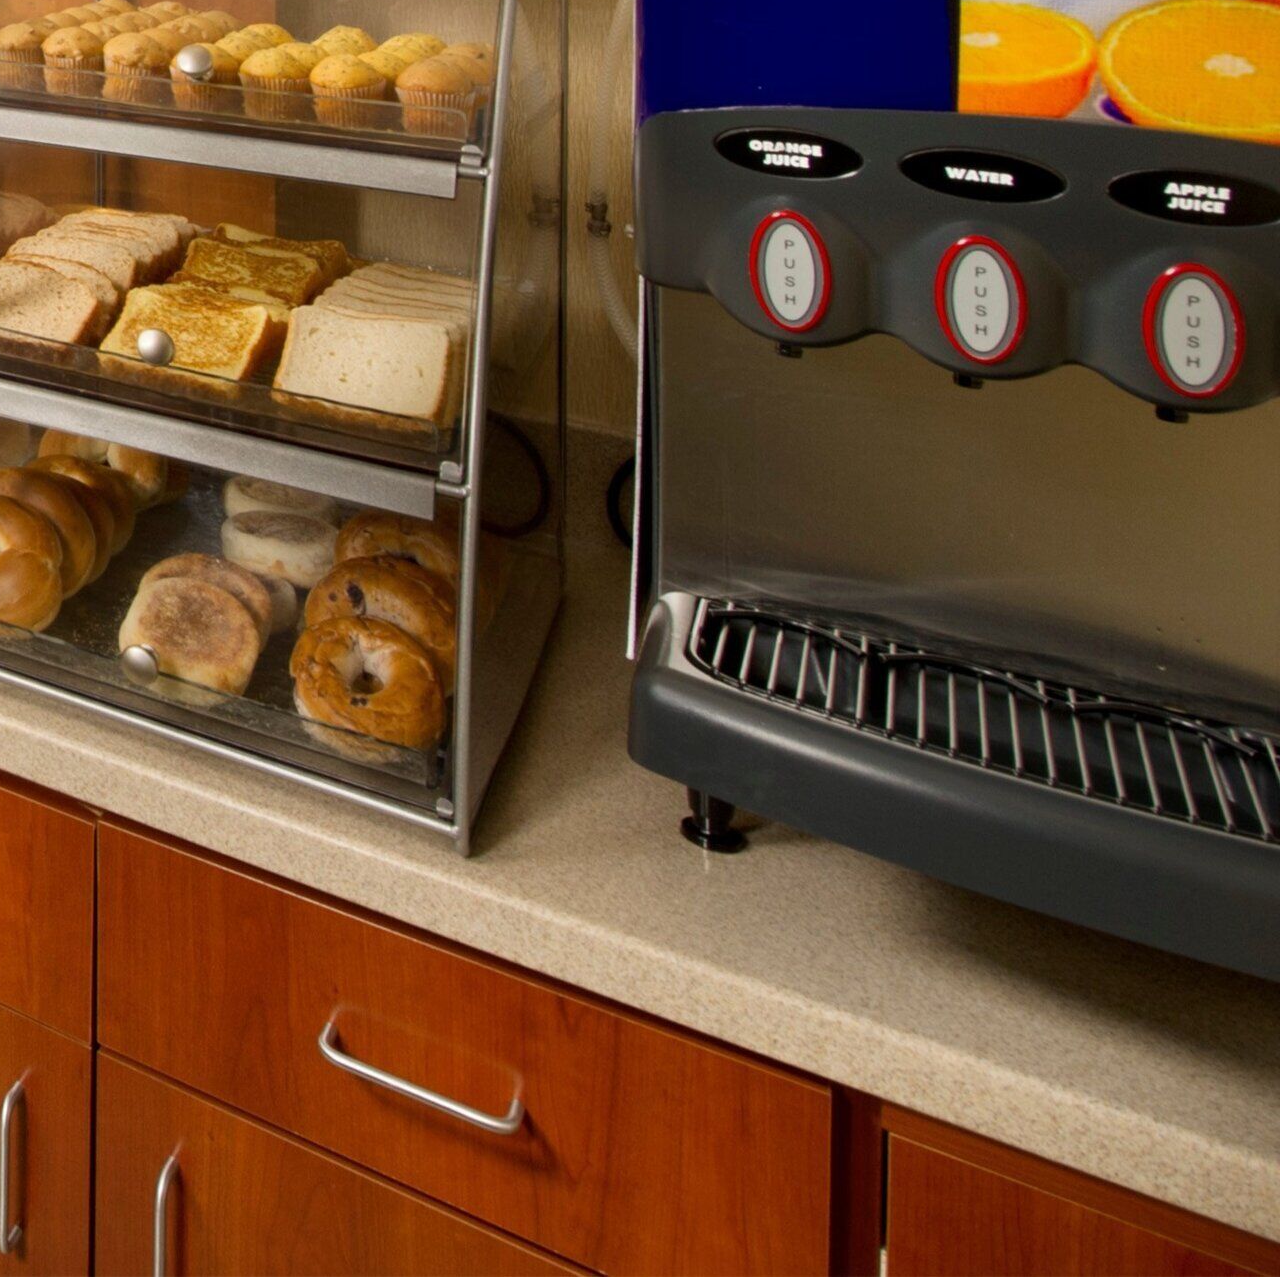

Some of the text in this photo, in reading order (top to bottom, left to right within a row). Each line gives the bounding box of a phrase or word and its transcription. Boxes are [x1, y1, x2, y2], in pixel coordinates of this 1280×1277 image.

[748, 139, 823, 158] ORANGE
[762, 153, 810, 169] JUICE
[944, 166, 1015, 186] WATER
[1164, 182, 1231, 201] APPLE
[1167, 197, 1226, 215] JUICE
[783, 239, 798, 307] PUSH
[974, 267, 988, 337] PUSH
[1185, 295, 1202, 369] PUSH
